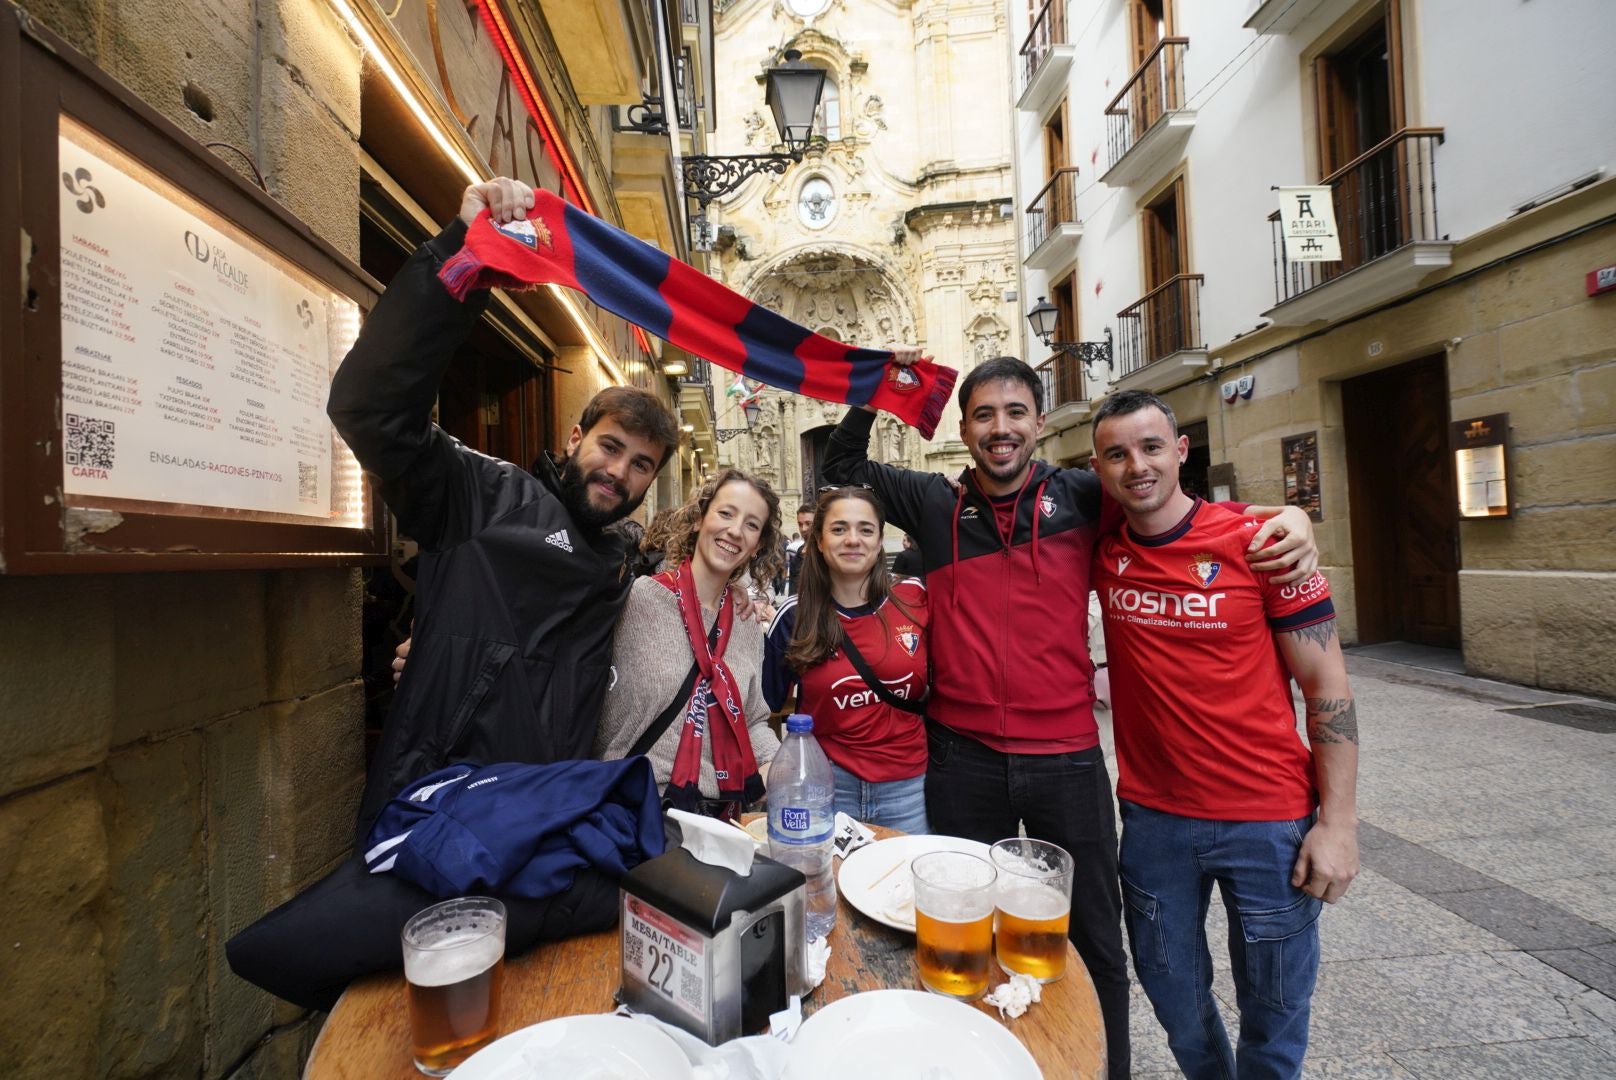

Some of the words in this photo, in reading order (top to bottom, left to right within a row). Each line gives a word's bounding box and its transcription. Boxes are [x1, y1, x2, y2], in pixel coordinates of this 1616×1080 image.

[1292, 220, 1326, 228] ATARI
[213, 245, 226, 259] CASA
[213, 256, 248, 288] ALCALDE
[72, 466, 108, 480] CARTA
[545, 536, 574, 552] adidas
[1108, 587, 1226, 617] kosner
[1127, 614, 1182, 628] Climatización
[1184, 620, 1228, 629] eficiente
[833, 684, 912, 710] veral
[784, 810, 807, 820] Font
[784, 818, 808, 829] Vella
[632, 918, 698, 967] MESA/TABLE
[648, 945, 674, 999] 22
